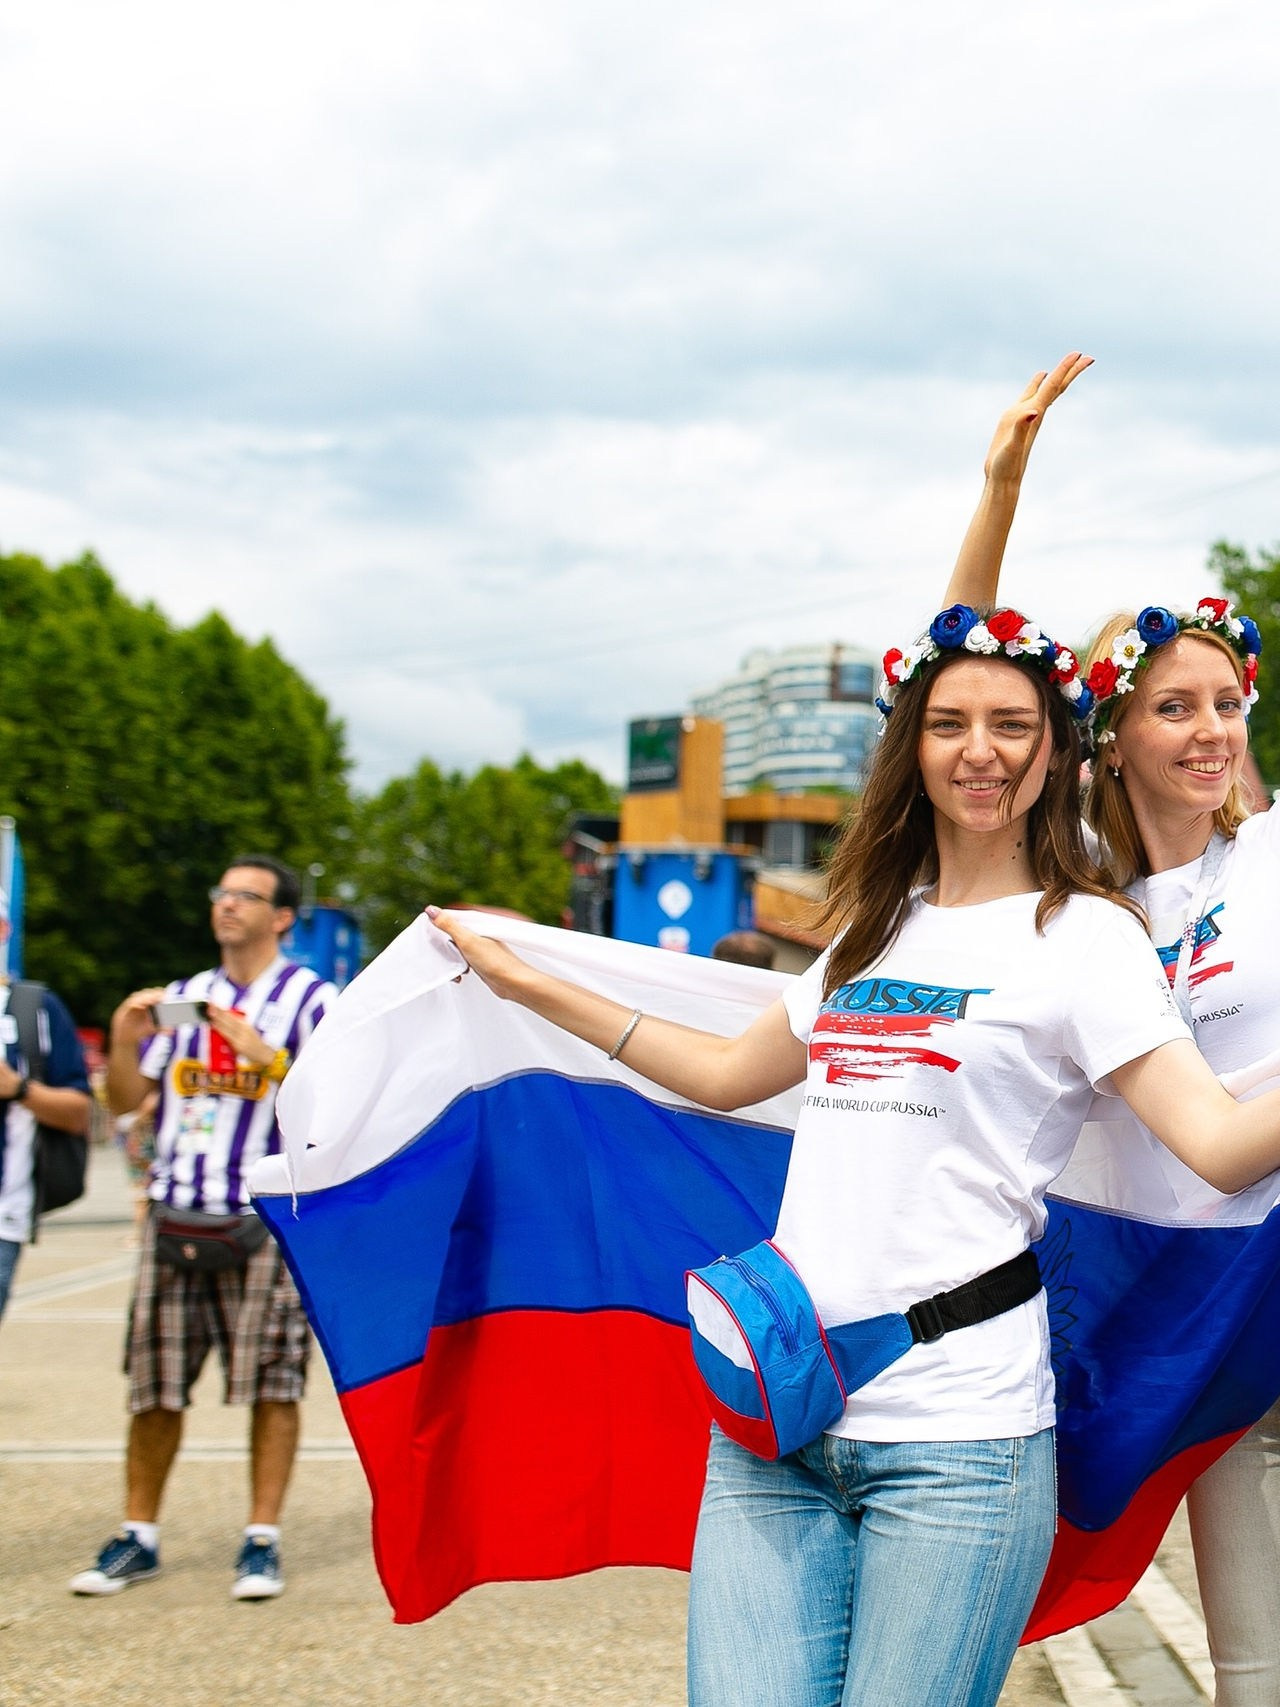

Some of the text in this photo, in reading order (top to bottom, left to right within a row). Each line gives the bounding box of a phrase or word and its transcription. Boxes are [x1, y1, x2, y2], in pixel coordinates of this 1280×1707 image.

[831, 980, 971, 1020] RUSSIA
[806, 1095, 830, 1108] FIFA
[832, 1099, 869, 1112] WORLD
[870, 1101, 890, 1112] CUP
